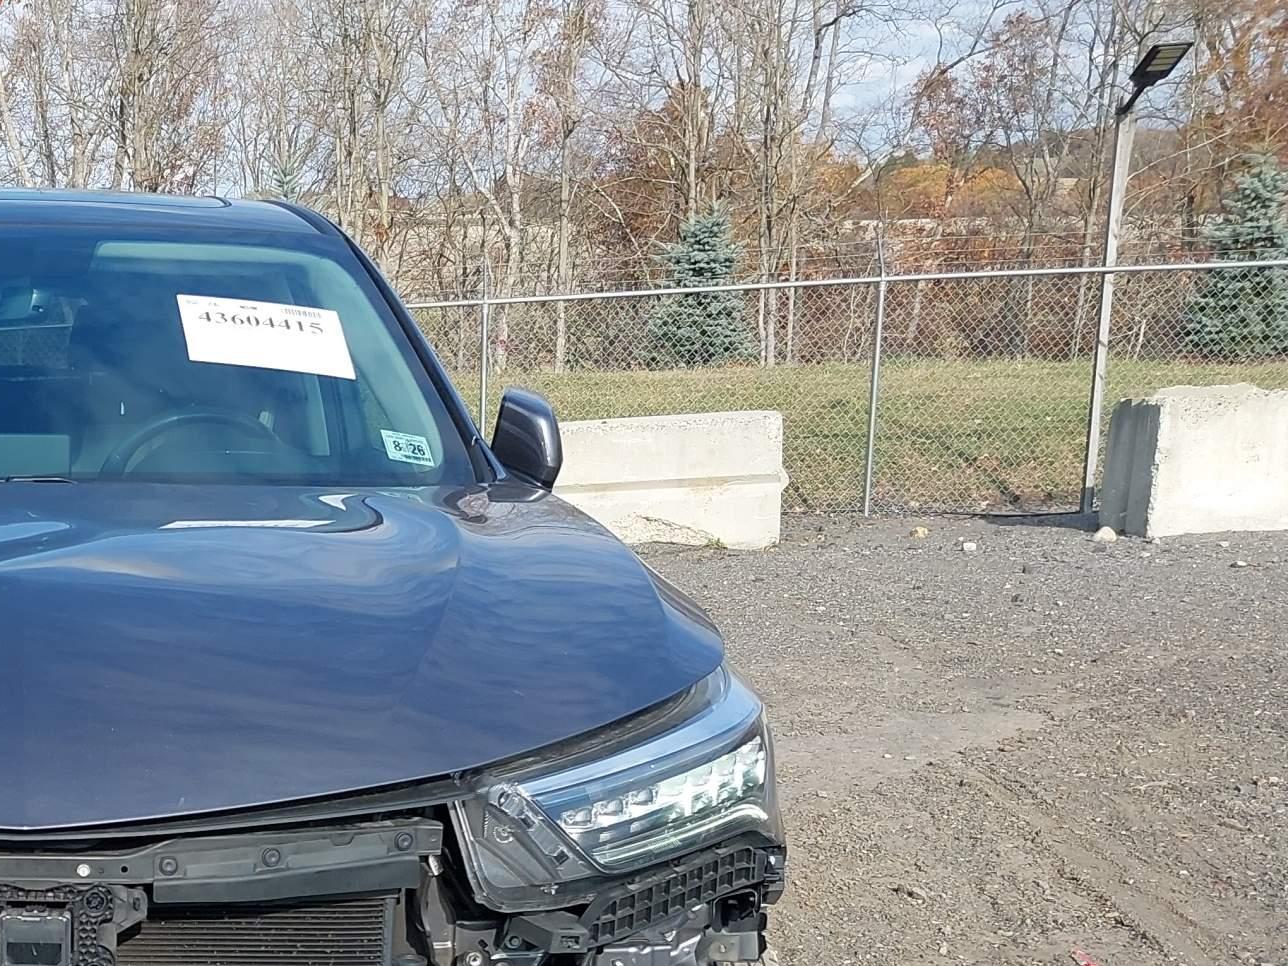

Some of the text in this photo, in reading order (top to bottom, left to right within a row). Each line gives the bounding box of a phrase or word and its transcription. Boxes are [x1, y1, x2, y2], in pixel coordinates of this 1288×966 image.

[198, 311, 324, 335] 43604415
[392, 440, 426, 456] 8 26
